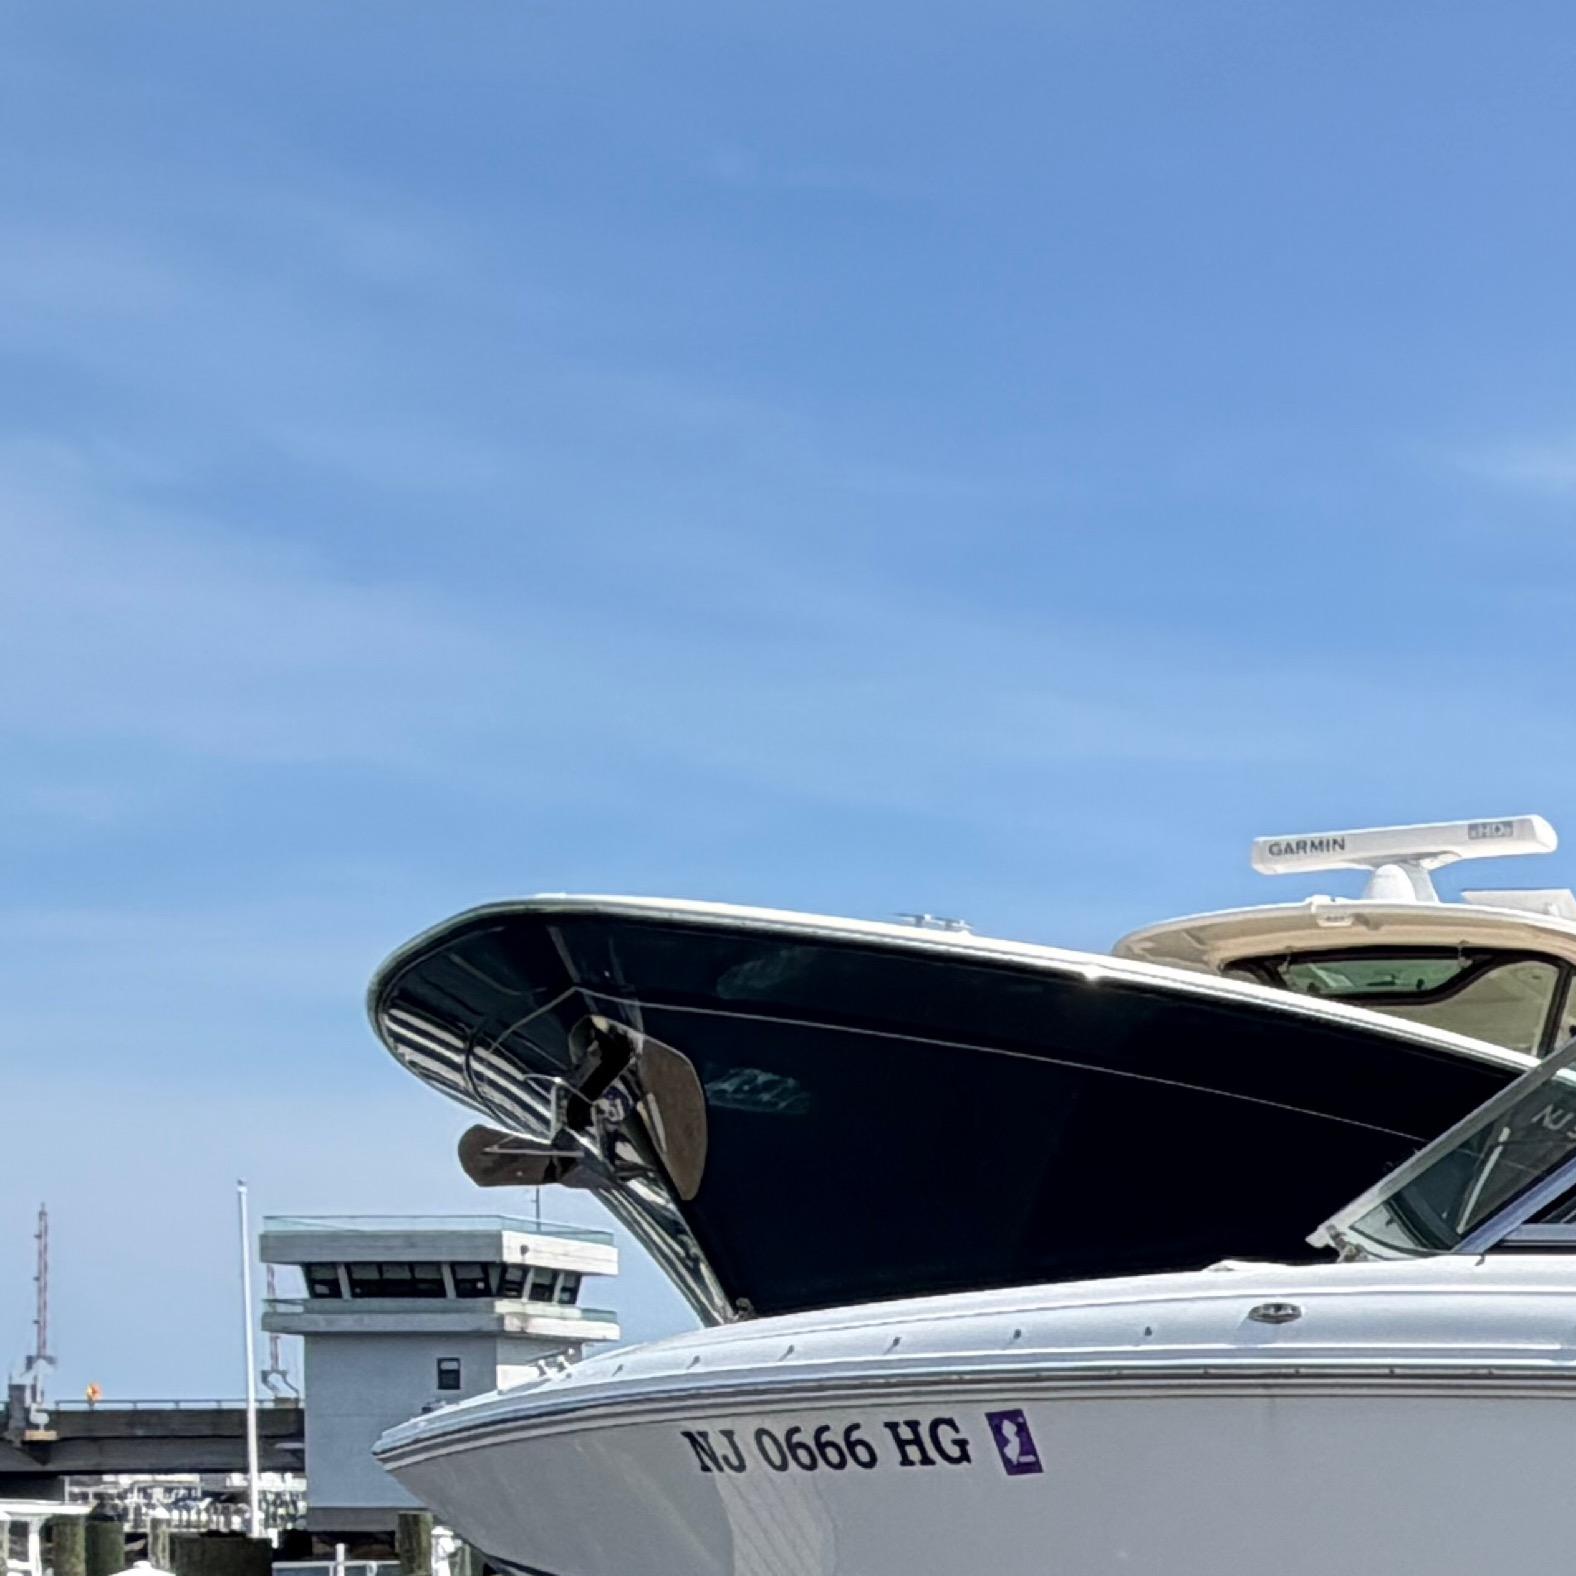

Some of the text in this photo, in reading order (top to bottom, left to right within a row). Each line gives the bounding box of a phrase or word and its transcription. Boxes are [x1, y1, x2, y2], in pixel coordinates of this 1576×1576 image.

[1268, 836, 1345, 856] GARMIN
[1531, 1104, 1574, 1130] NJ
[680, 1416, 972, 1473] NJ 0666 HG
